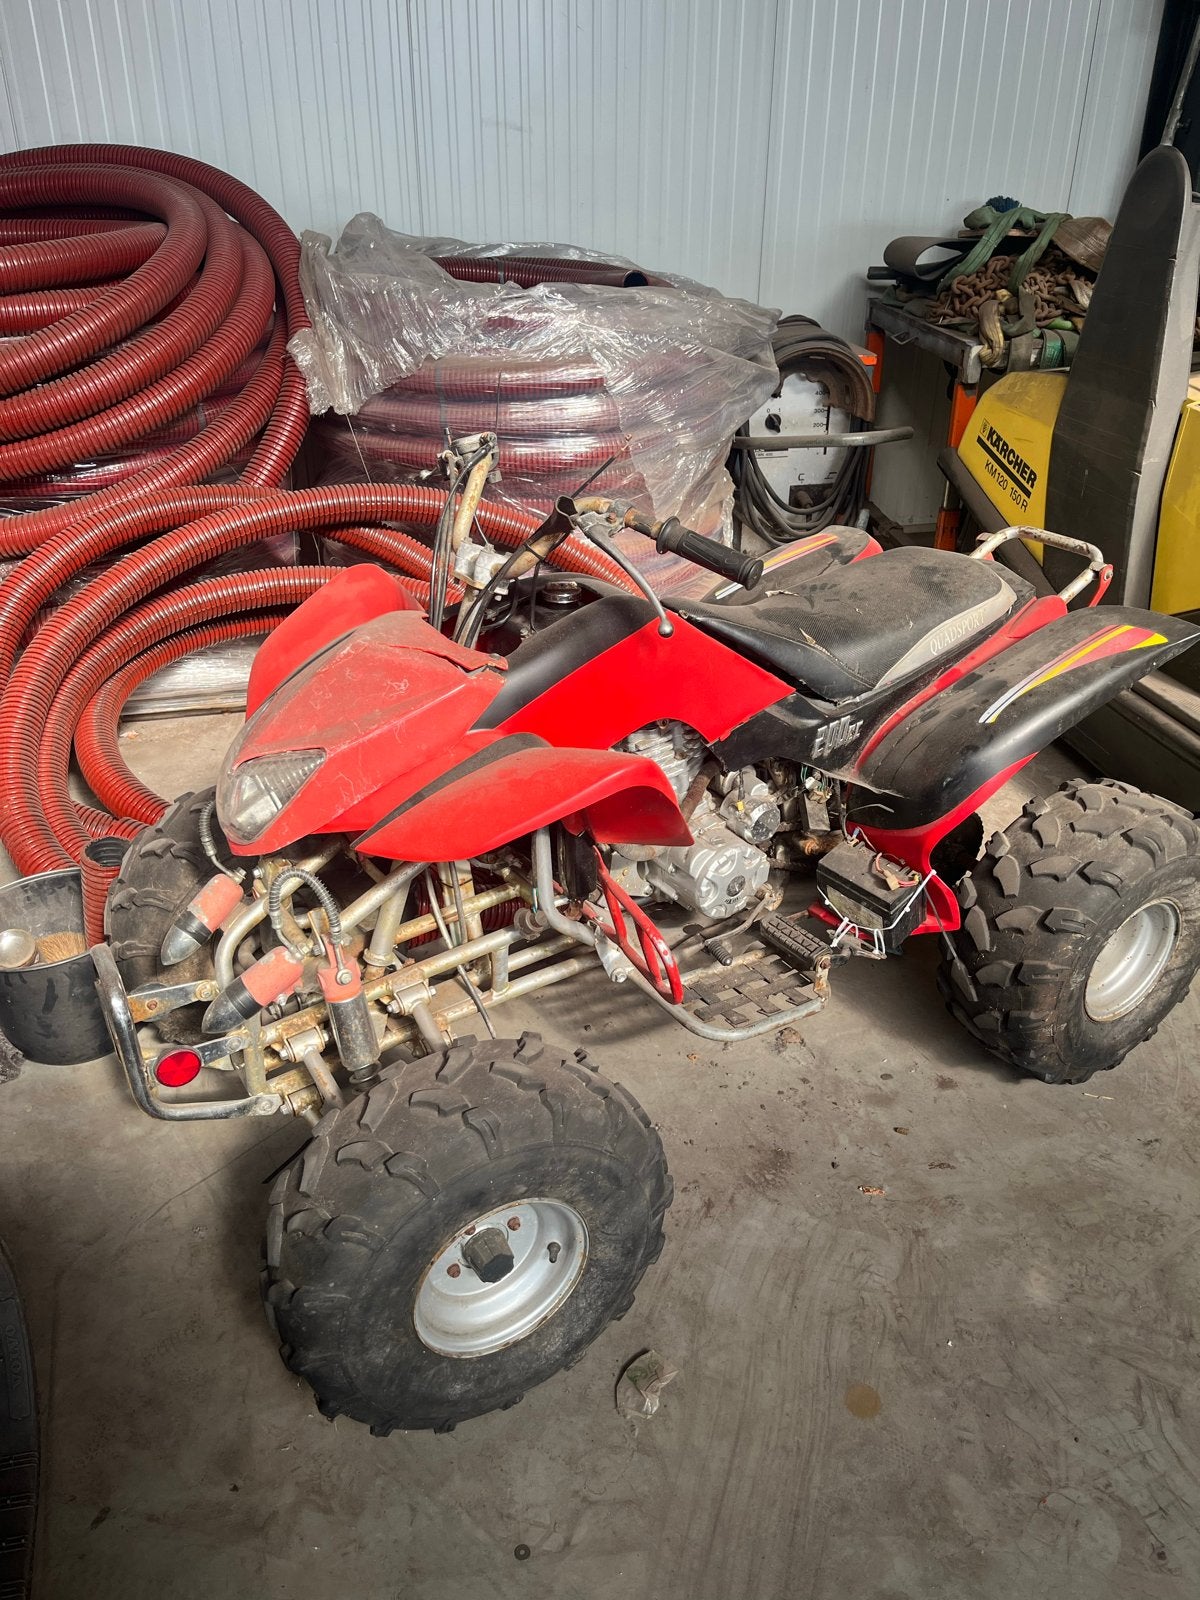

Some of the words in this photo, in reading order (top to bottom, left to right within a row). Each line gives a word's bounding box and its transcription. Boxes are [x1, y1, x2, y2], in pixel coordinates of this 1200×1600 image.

[984, 459, 998, 479] KM
[996, 472, 1009, 490] 120
[1009, 487, 1022, 506] 150
[1020, 499, 1028, 513] R
[930, 608, 985, 656] QUADSPORT
